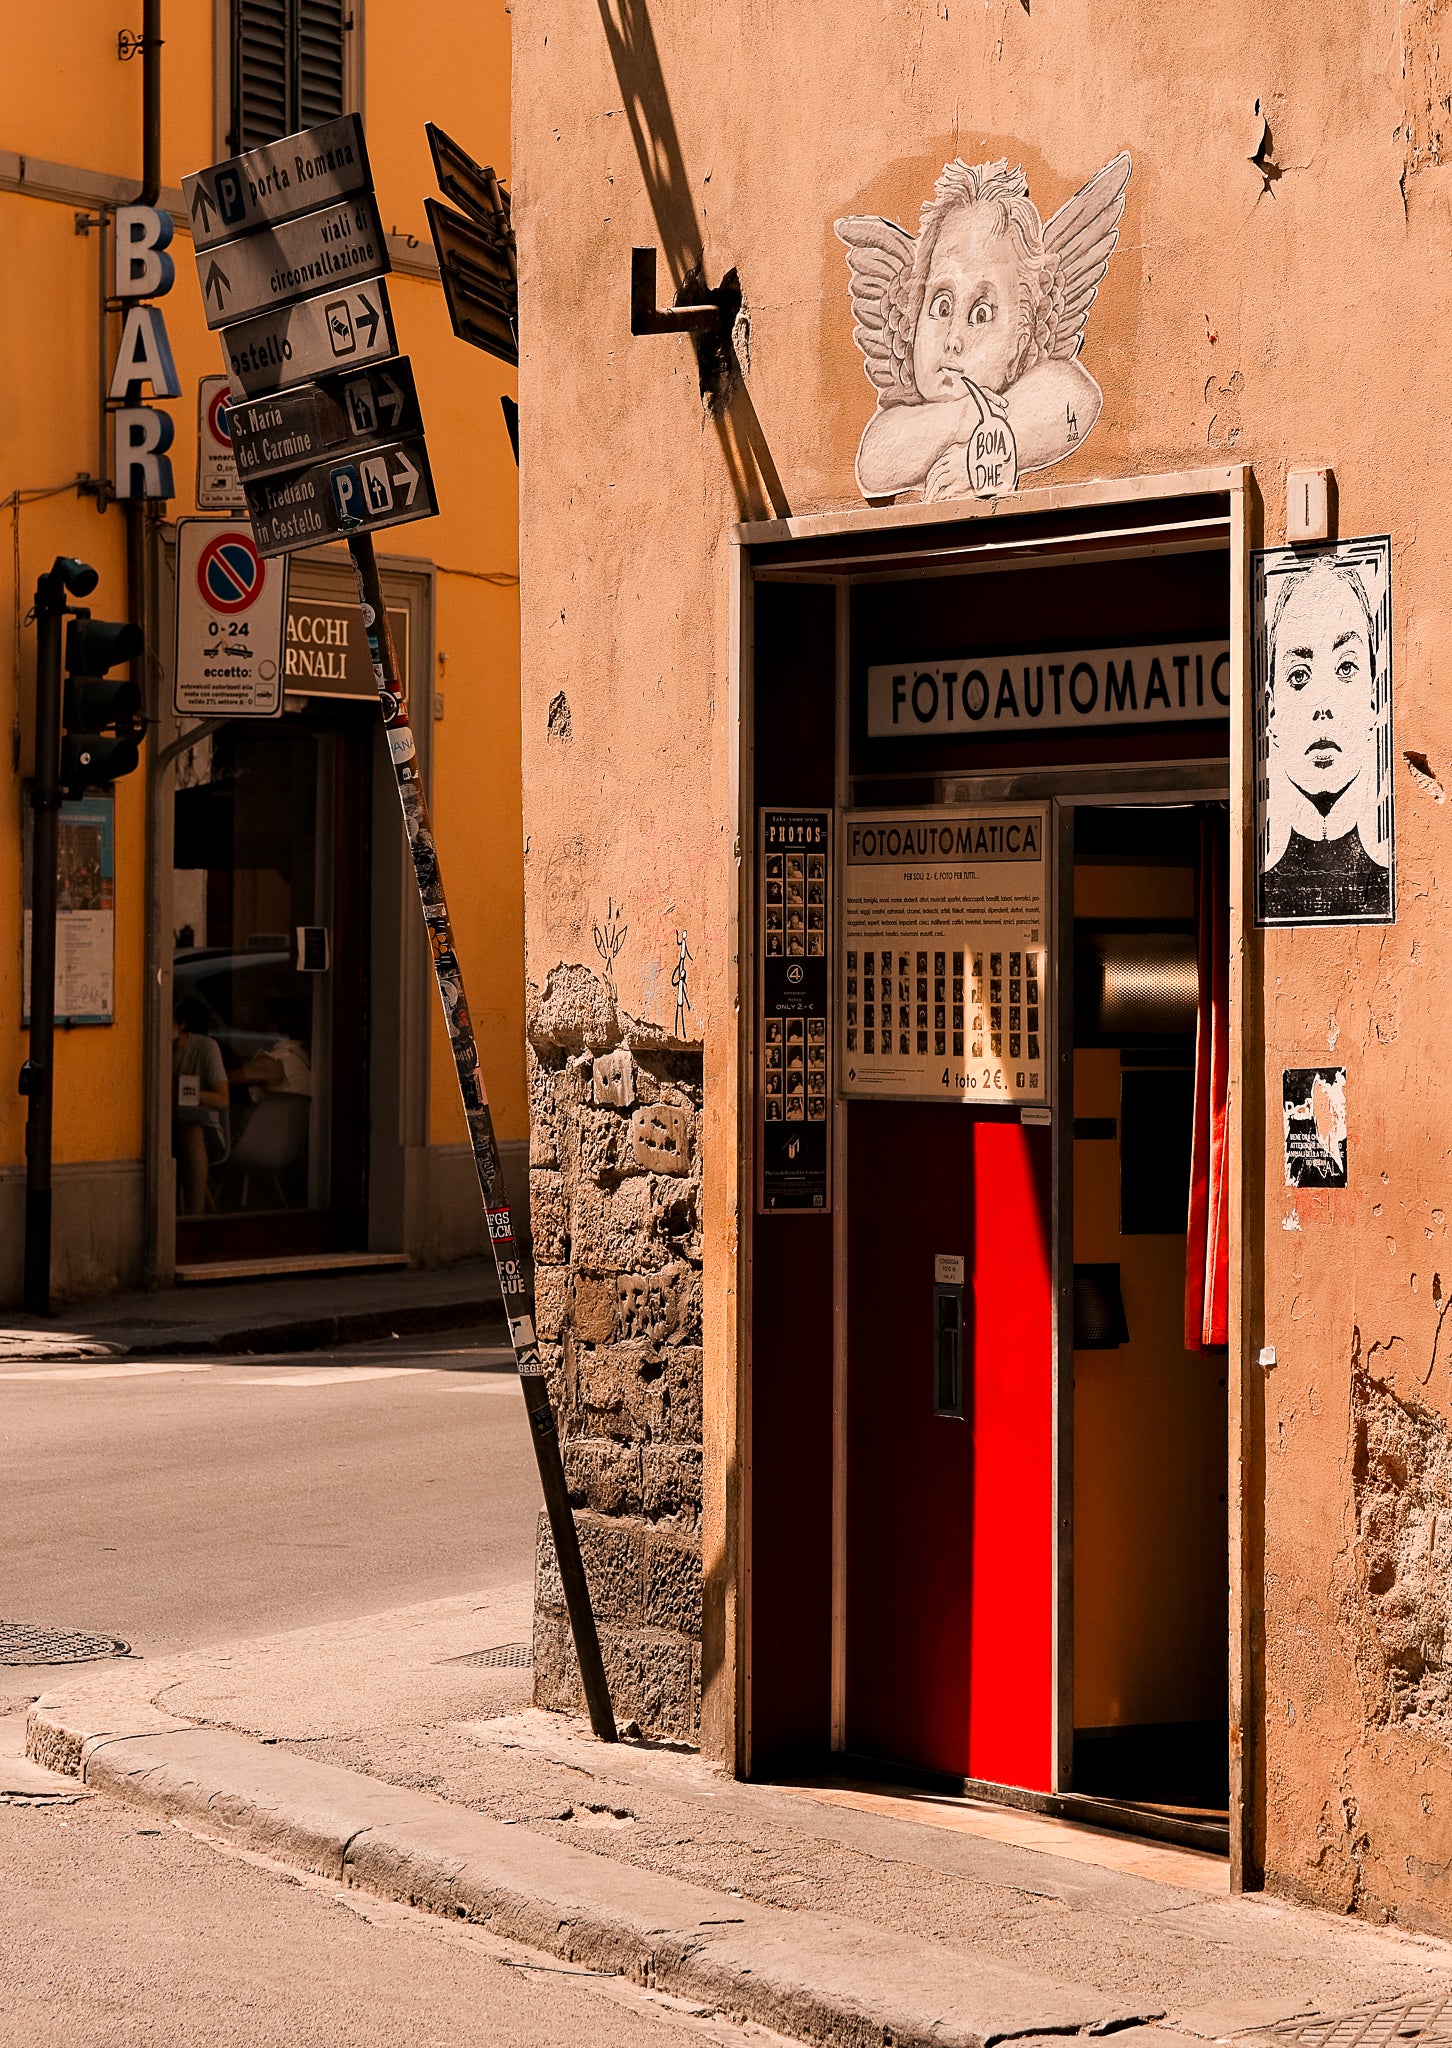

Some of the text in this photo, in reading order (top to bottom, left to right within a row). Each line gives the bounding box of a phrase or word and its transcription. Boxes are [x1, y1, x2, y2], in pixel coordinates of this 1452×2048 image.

[248, 166, 291, 207] porta
[294, 143, 354, 184] Romana
[320, 207, 367, 243] viali di
[269, 239, 374, 293] circonvallazione
[110, 205, 180, 499] BAR
[233, 404, 283, 437] S. Maria
[240, 431, 312, 468] del Carmine
[251, 480, 315, 513] S. Frediano
[257, 524, 270, 545] in
[272, 510, 322, 541] Cestello
[204, 667, 252, 678] eccetto:
[770, 826, 821, 843] PHOTOS
[852, 825, 1037, 857] FOTOAUTOMATICA
[942, 1067, 950, 1088] 4
[955, 1073, 977, 1089] foto
